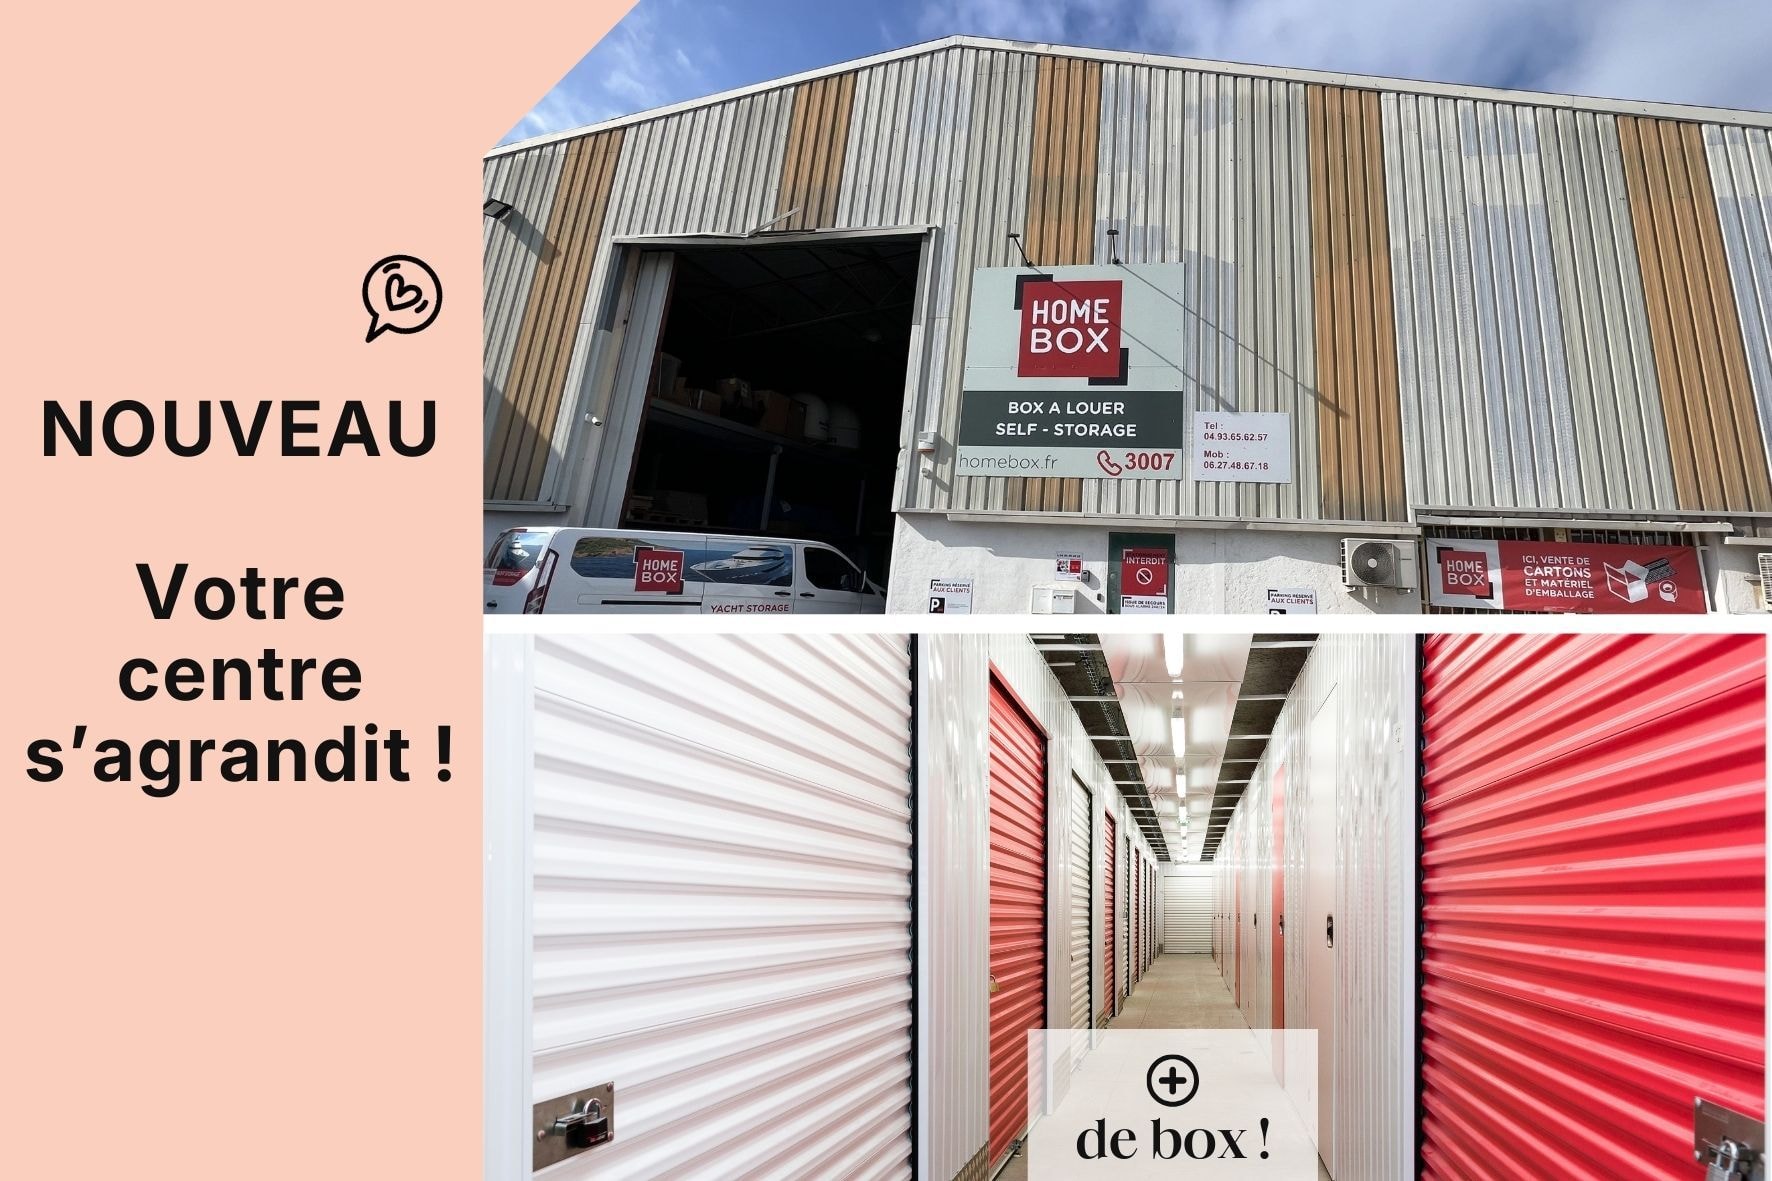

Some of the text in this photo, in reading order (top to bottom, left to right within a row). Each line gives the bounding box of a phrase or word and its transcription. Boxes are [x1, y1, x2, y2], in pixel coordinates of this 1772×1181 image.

[1032, 298, 1110, 325] HOME
[1030, 327, 1110, 354] BOX
[1008, 401, 1125, 415] BOX A LOUER
[995, 423, 1037, 436] SELF
[1053, 423, 1137, 437] STORAGE
[1204, 422, 1218, 430] Tel
[1203, 432, 1268, 441] 04.93.65.62.57
[1203, 450, 1224, 459] Mob
[959, 452, 1175, 471] homebox.fr 3007
[1203, 461, 1269, 470] 06.27.48.67.18
[642, 559, 678, 571] HOME
[1126, 556, 1166, 565] INTERDIT
[1446, 560, 1484, 573] HOME
[1522, 555, 1591, 566] ICI, VENTE DE
[641, 571, 677, 583] BOX
[1523, 566, 1592, 579] CARTONS
[1447, 573, 1485, 586] BOX
[1525, 578, 1593, 589] ET MATÉRIEL
[1525, 588, 1595, 599] D'EMBALLAGE
[711, 604, 789, 613] YACHT STORAGE
[930, 598, 940, 612] P
